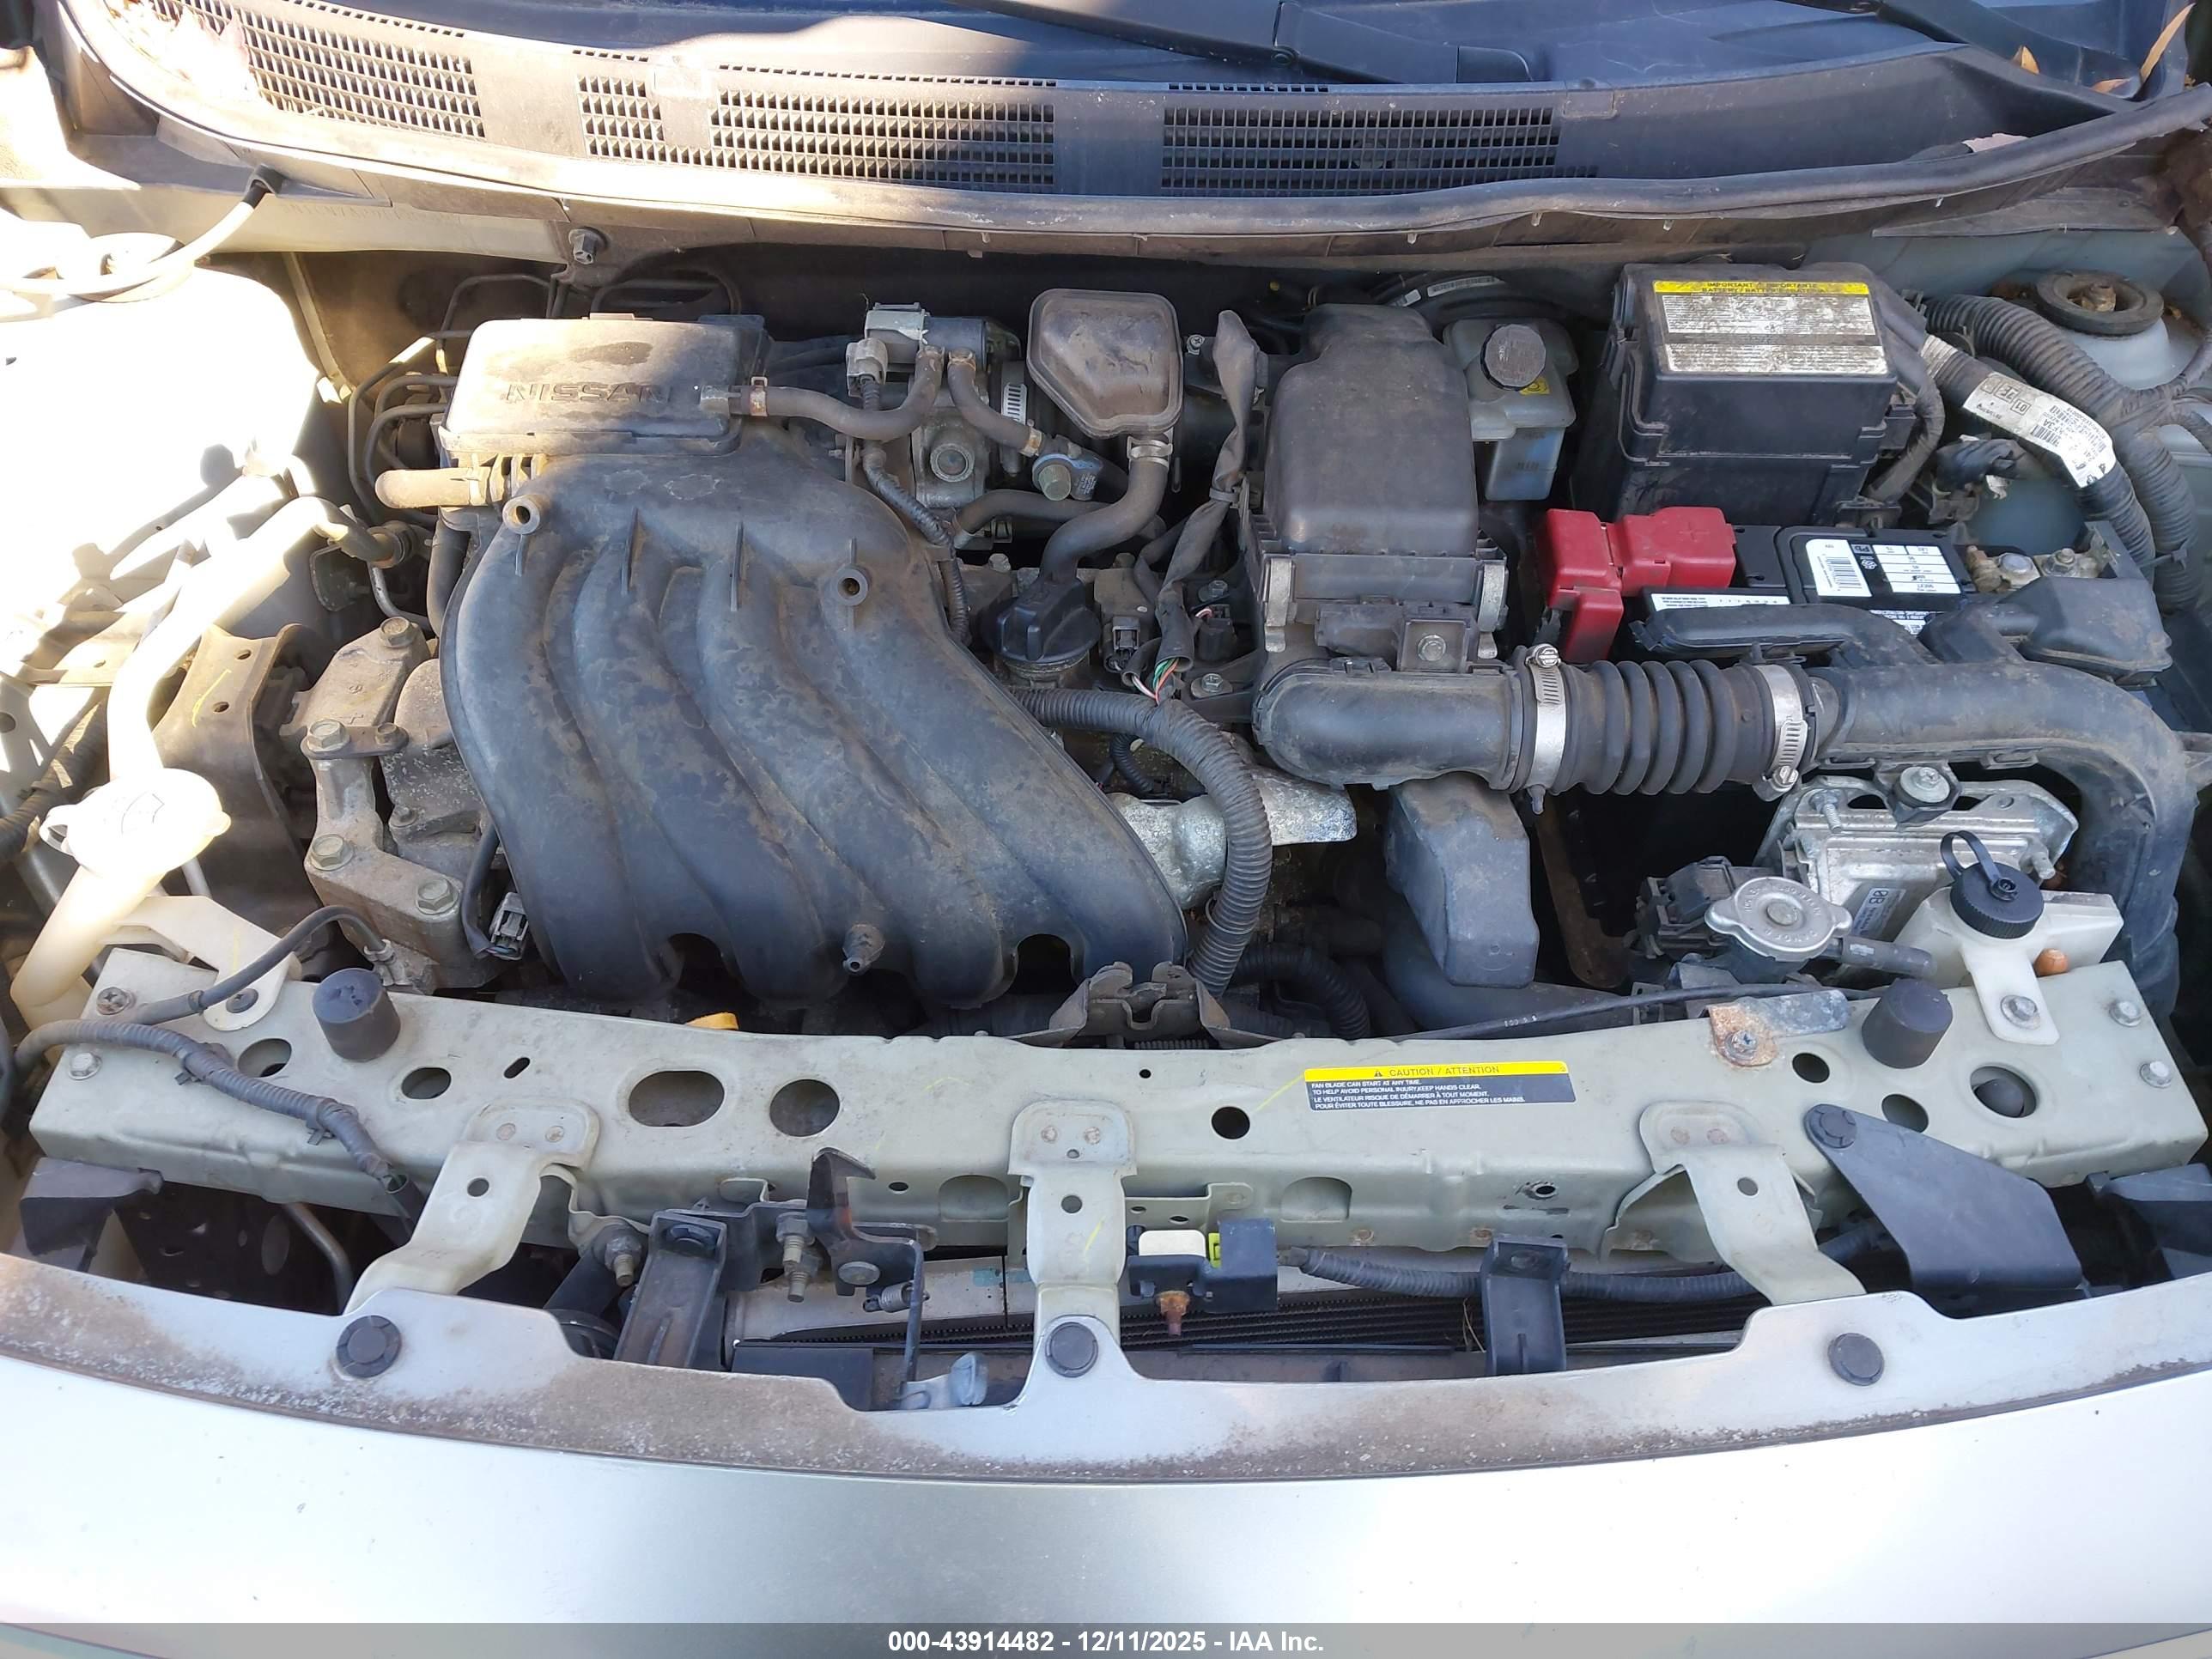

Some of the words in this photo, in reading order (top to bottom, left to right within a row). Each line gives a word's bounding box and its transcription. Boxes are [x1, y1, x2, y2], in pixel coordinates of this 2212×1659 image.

[505, 382, 672, 404] NISSAN
[1389, 1067, 1434, 1077] CAUTION
[1445, 1066, 1499, 1074] ATTENTION
